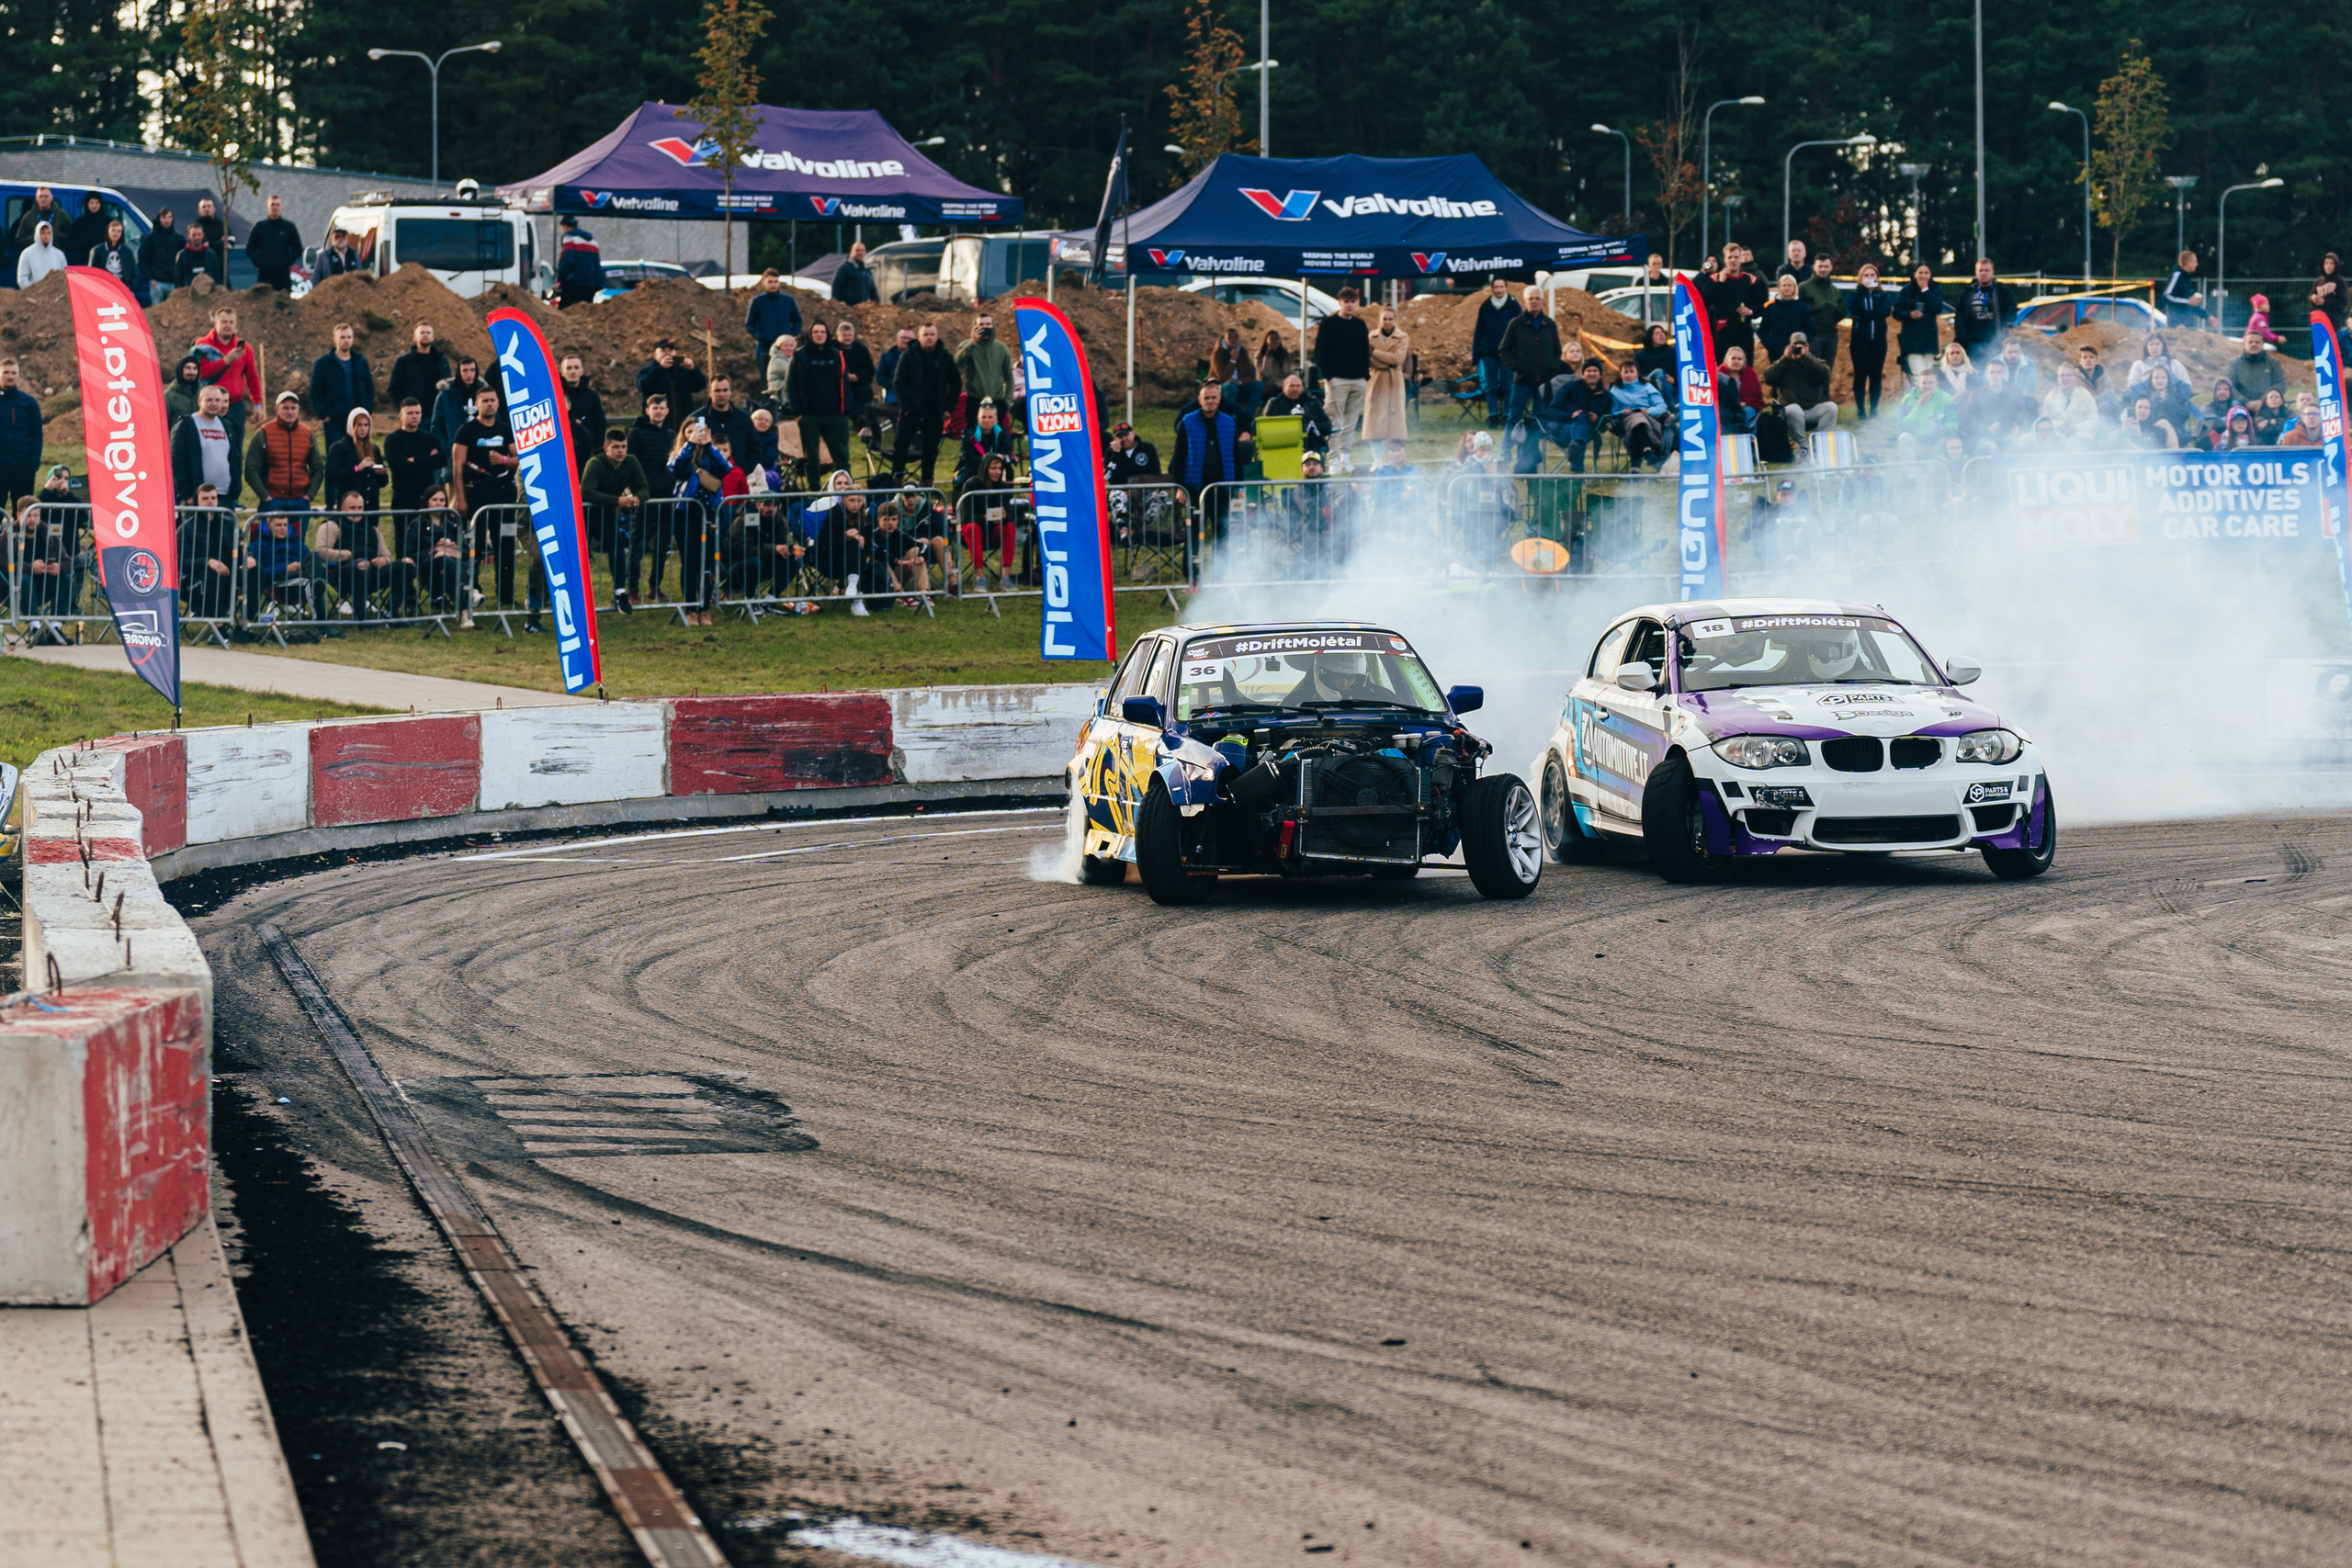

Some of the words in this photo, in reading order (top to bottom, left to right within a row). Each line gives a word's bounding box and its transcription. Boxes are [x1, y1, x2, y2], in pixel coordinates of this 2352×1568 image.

[737, 148, 905, 178] Valvoline
[612, 196, 679, 211] Valvoline
[840, 203, 906, 219] Valvoline
[1322, 193, 1498, 218] Valvoline
[1184, 255, 1265, 272] Valvoline
[2017, 468, 2128, 504] LIQUI
[2145, 463, 2242, 488] MOTOR
[2247, 462, 2310, 485] OILS
[2157, 489, 2301, 513] ADDITIVES
[2020, 509, 2132, 543] MOLY
[2164, 516, 2220, 539] CAR
[2225, 514, 2300, 538] CARE
[1702, 624, 1724, 633] 18
[1190, 666, 1216, 676] 36
